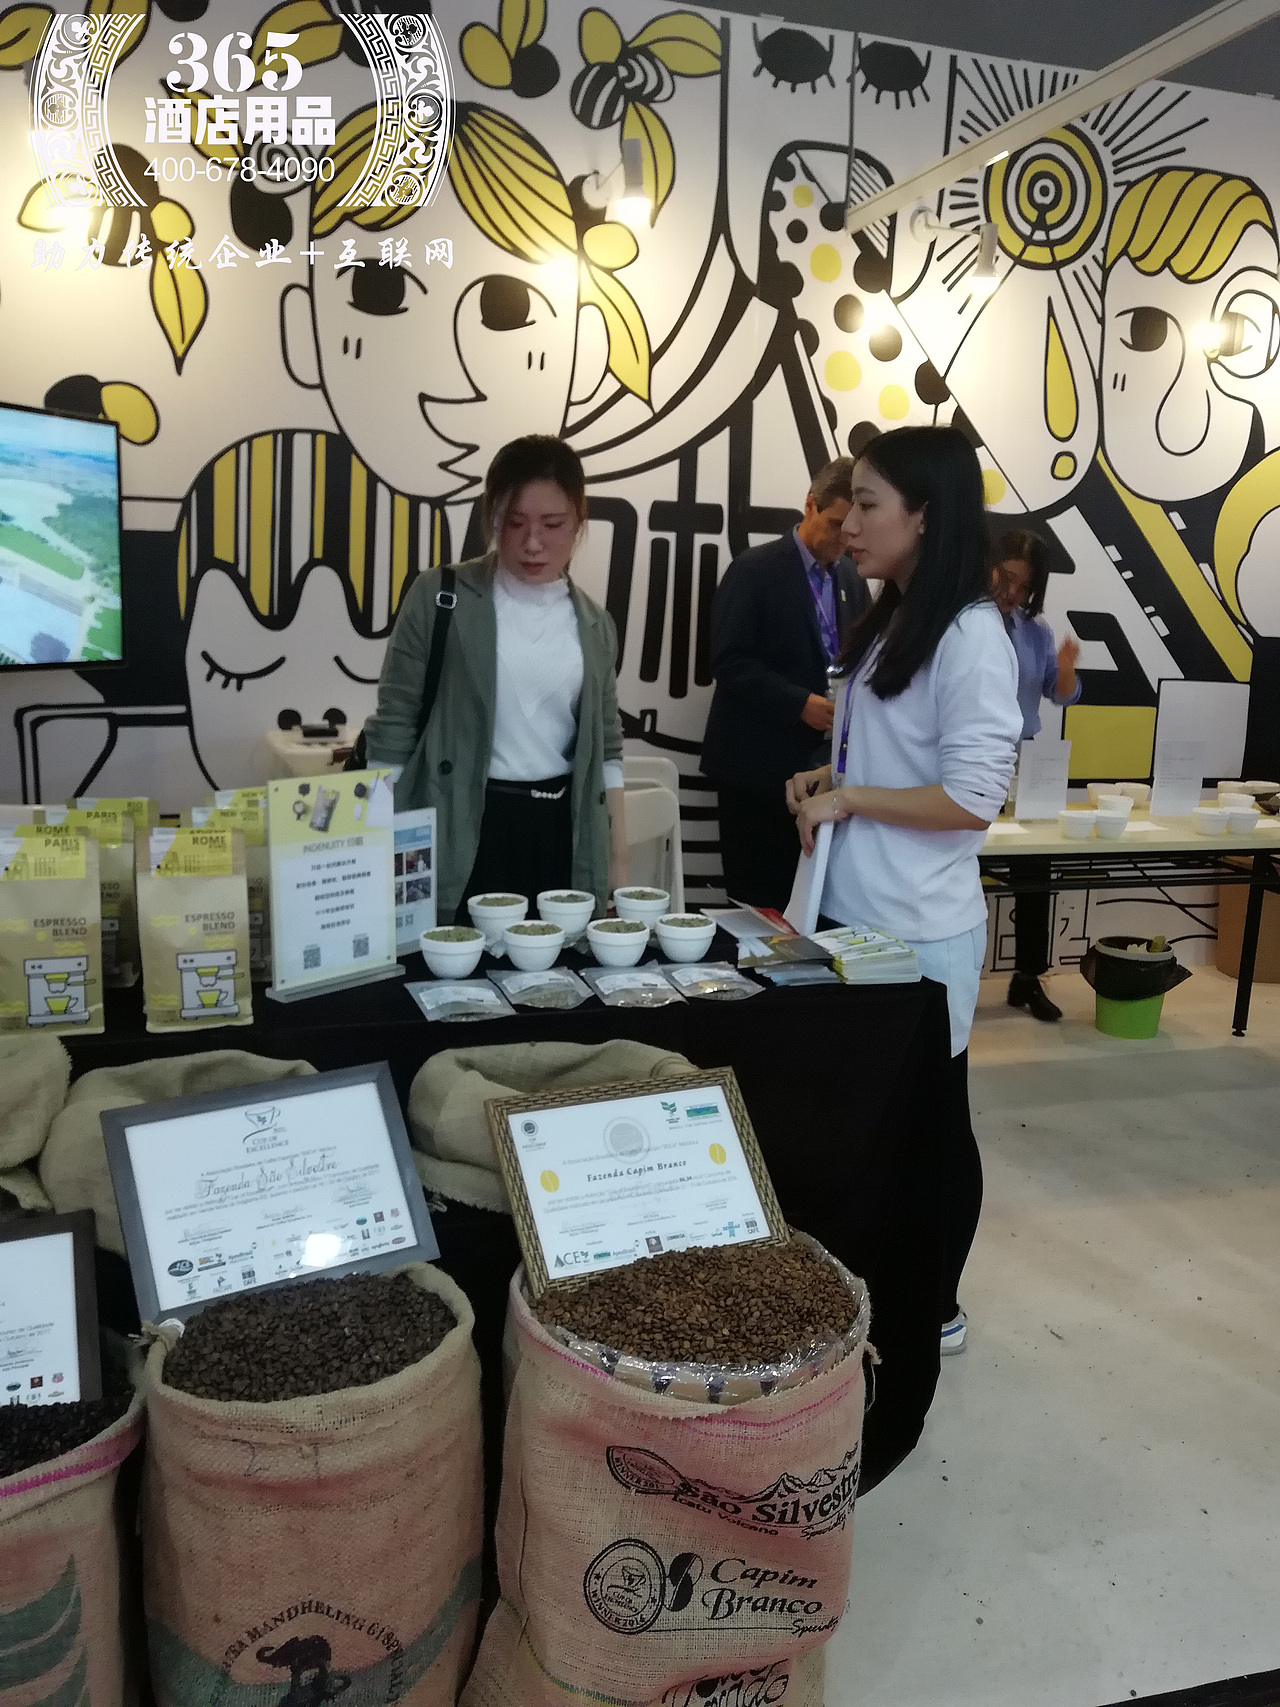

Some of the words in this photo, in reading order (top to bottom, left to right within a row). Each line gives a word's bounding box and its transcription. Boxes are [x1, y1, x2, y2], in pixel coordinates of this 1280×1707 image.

[33, 917, 87, 929] ESPRESSO
[184, 911, 235, 923] ESPRESSO
[202, 921, 236, 932] BLEND
[52, 927, 87, 938] BLEND
[587, 1168, 624, 1182] Fazenda
[626, 1163, 655, 1177] Capim
[657, 1160, 687, 1171] Branco
[718, 1511, 780, 1536] Volcano
[710, 1557, 818, 1589] Capim
[701, 1587, 823, 1620] Branco
[246, 1600, 366, 1642] MANDHELING
